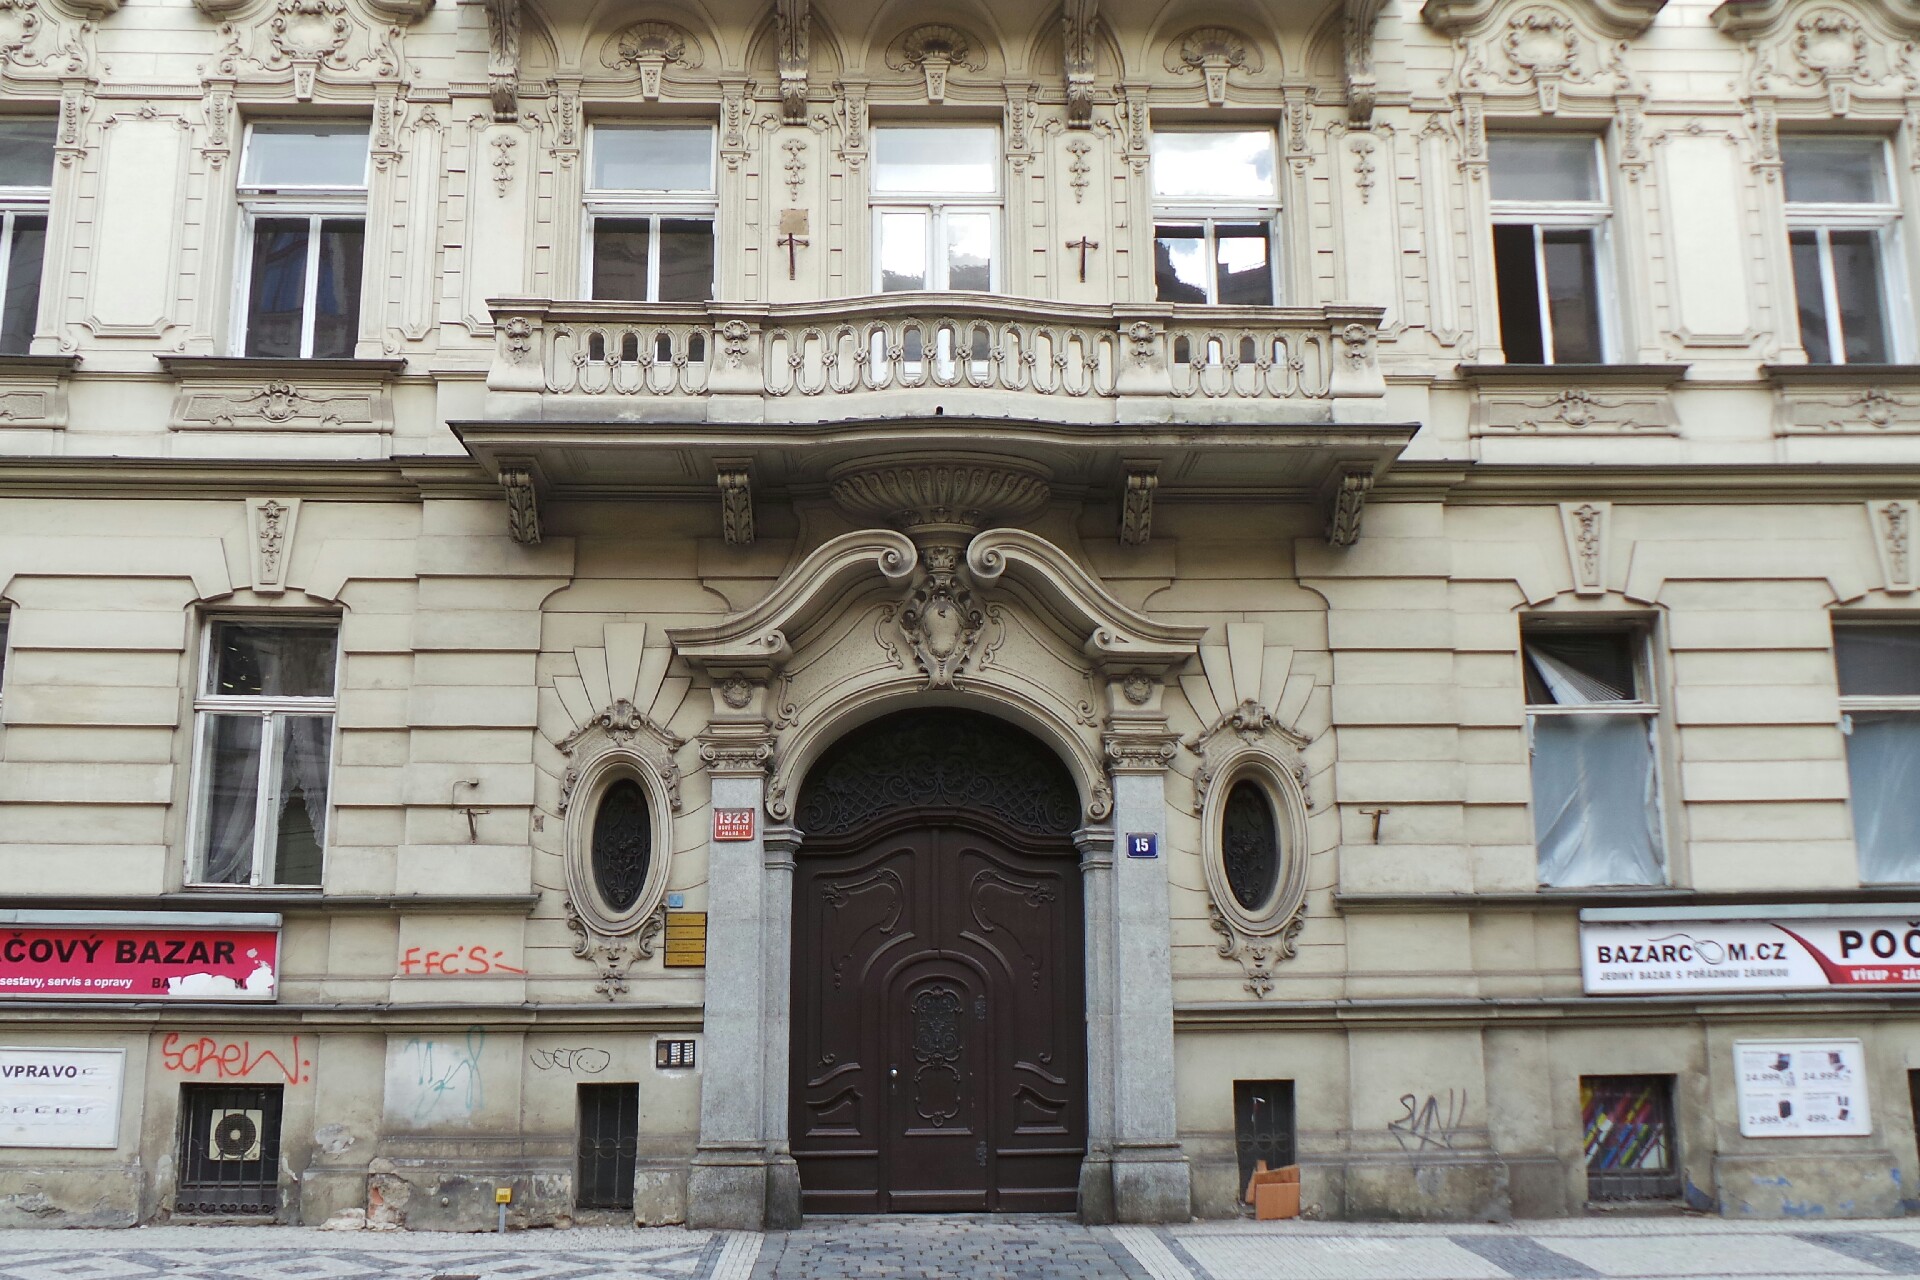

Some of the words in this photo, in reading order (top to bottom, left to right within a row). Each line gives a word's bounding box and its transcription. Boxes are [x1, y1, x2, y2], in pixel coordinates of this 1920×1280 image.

[719, 812, 750, 824] 1323
[1135, 838, 1149, 852] 15
[0, 932, 104, 963] ČOVÝ
[115, 939, 235, 964] BAZAR
[1639, 971, 1672, 980] BAZAR
[1676, 970, 1682, 979] S
[0, 977, 45, 988] sestavy,
[48, 977, 81, 987] servis
[84, 979, 91, 987] a
[94, 979, 133, 989] opravy
[2, 1065, 77, 1078] VPRAVO
